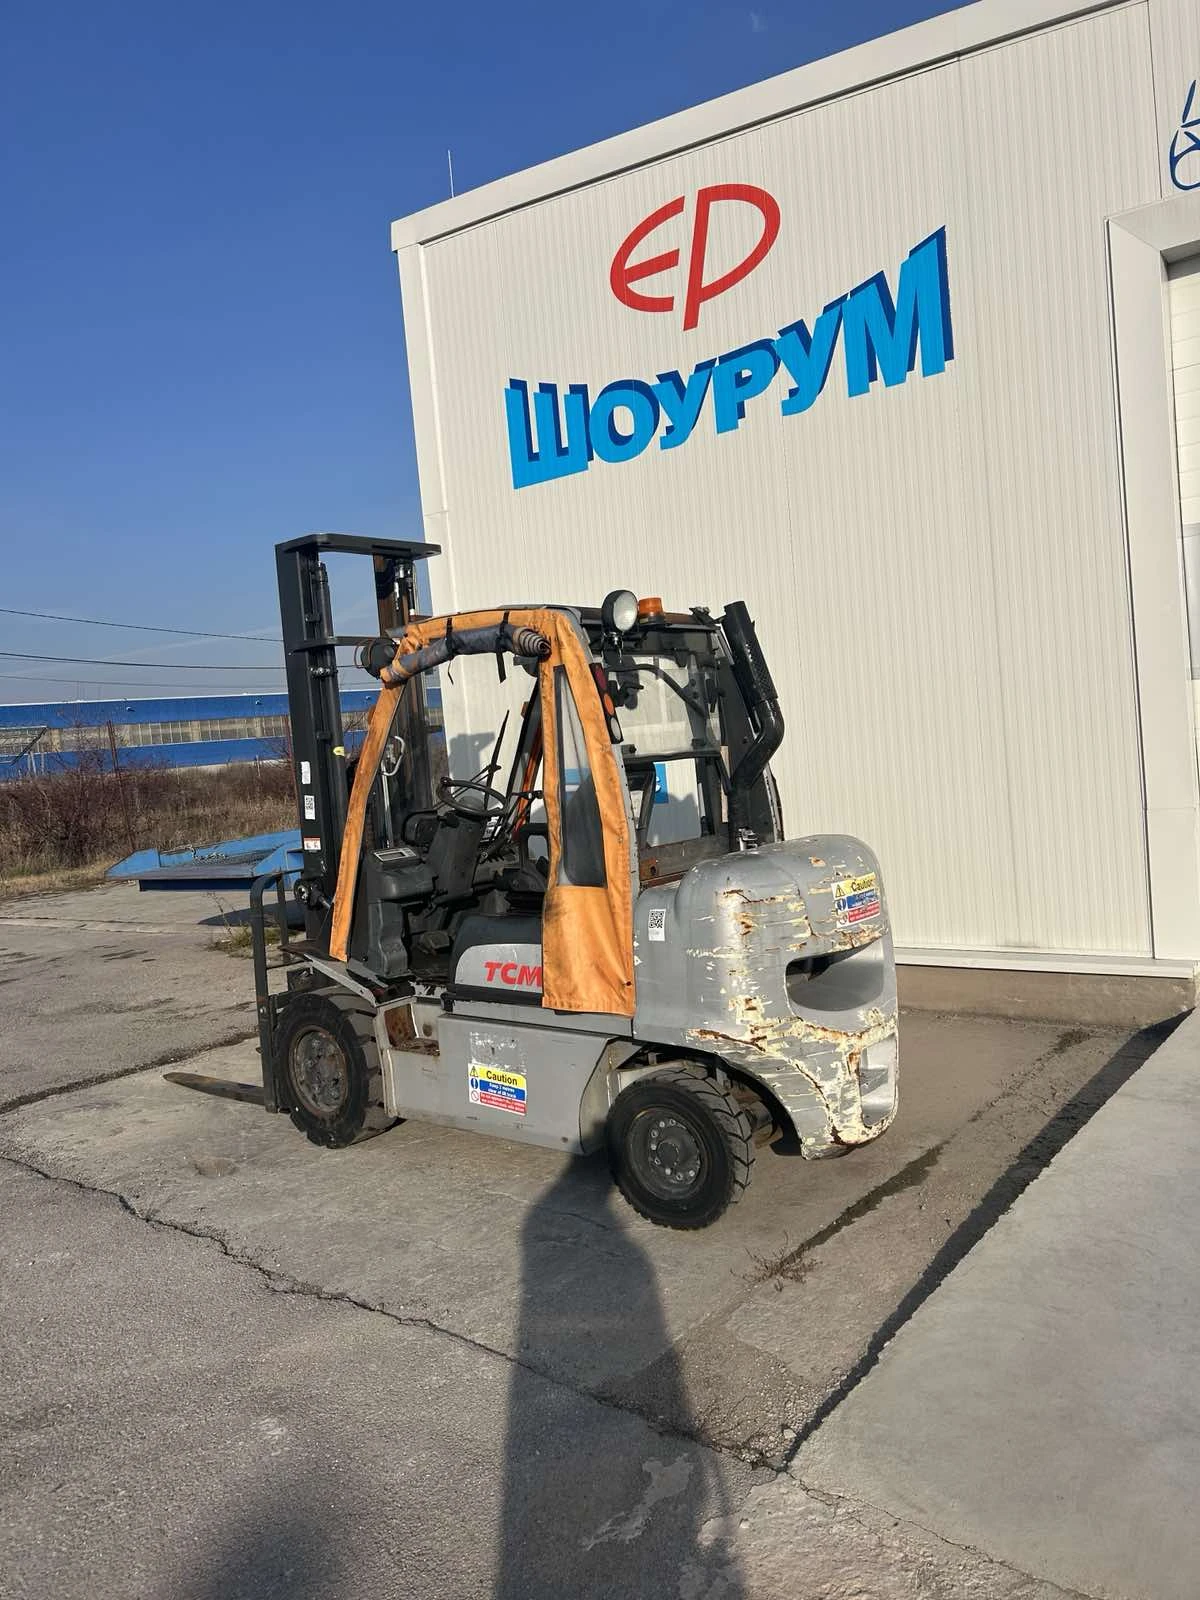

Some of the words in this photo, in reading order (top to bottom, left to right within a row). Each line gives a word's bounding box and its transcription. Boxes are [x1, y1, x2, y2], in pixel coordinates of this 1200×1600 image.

[504, 225, 954, 489] ШОУРУМ
[484, 961, 542, 987] TCM
[486, 1070, 518, 1086] Caution
